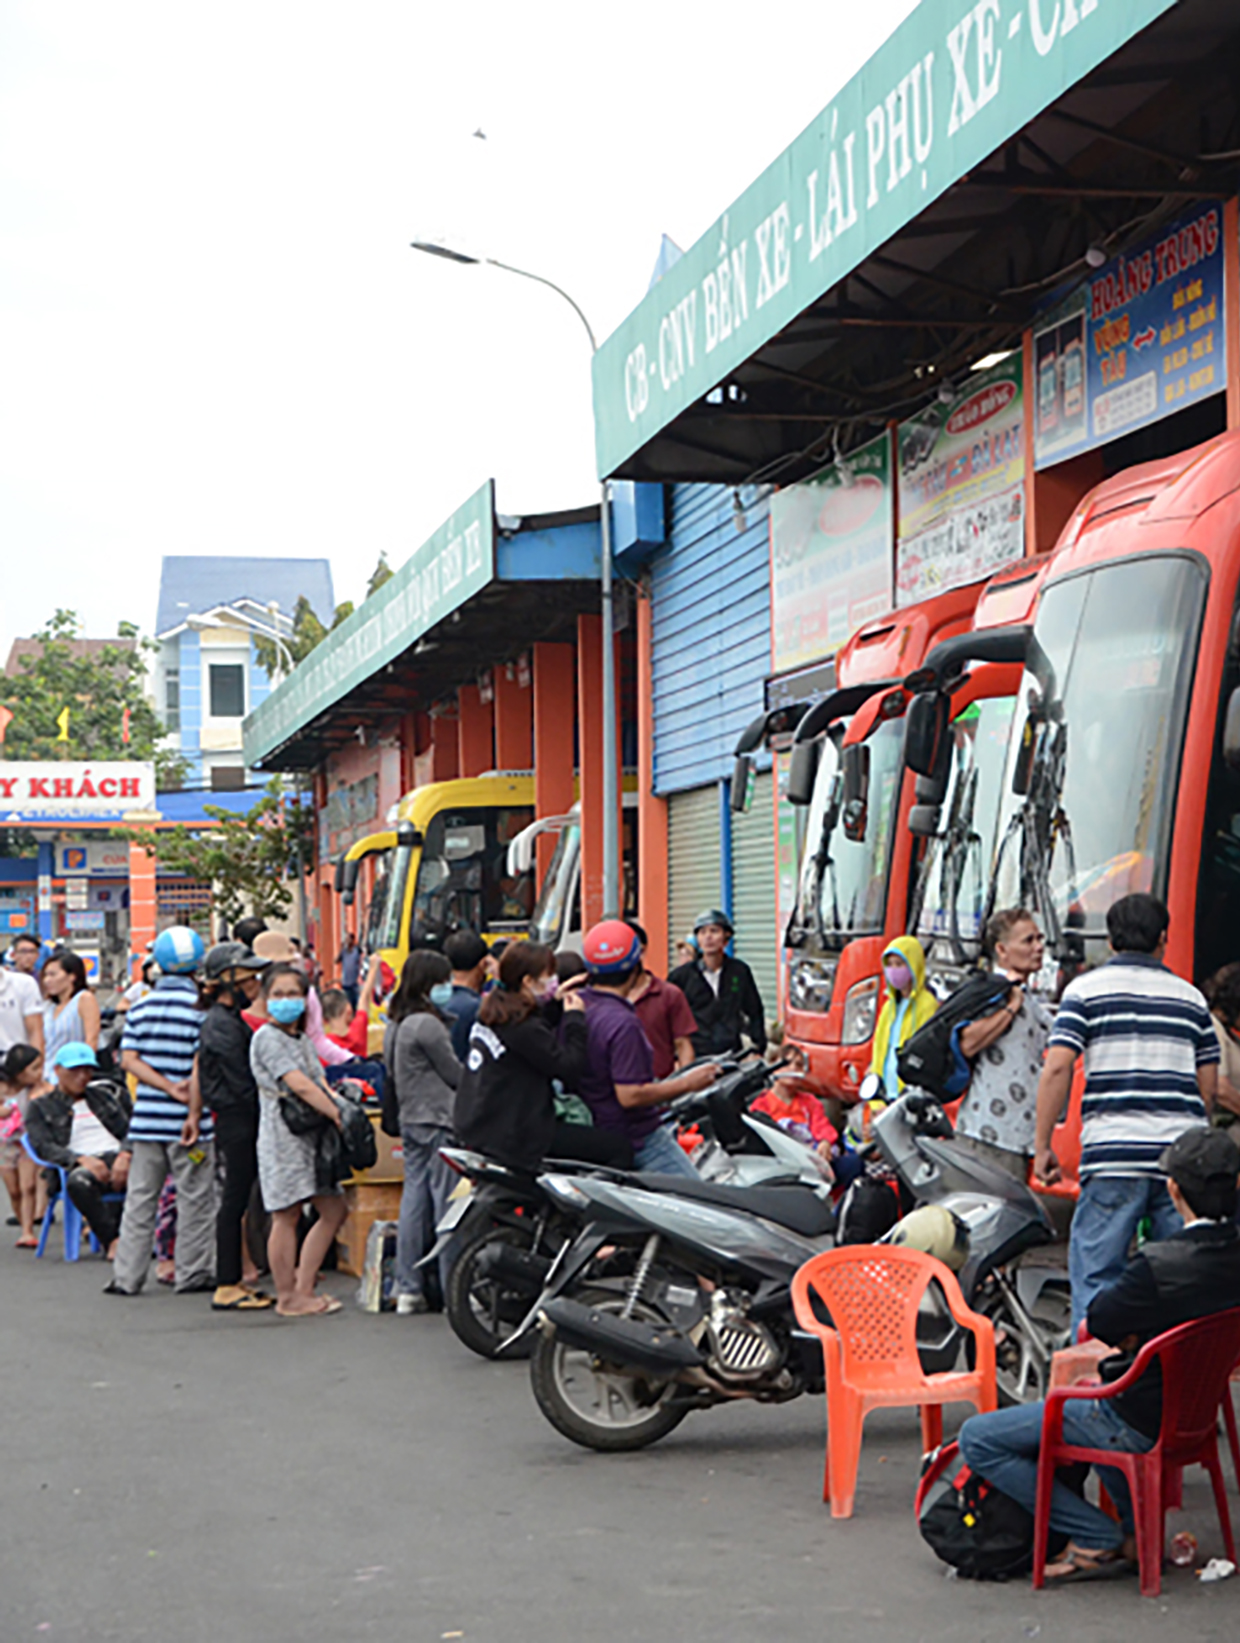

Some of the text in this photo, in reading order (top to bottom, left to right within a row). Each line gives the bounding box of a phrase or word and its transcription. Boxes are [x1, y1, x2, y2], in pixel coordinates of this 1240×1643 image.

[625, 343, 649, 423] CB
[659, 289, 697, 391] CNV
[703, 213, 748, 354] BẾN
[755, 201, 791, 310] XE
[807, 107, 858, 262] LÁI
[866, 51, 934, 210] PHỤ
[946, 0, 1002, 138] XE
[1155, 209, 1219, 284] TRUNG
[28, 769, 141, 798] KHÁCH
